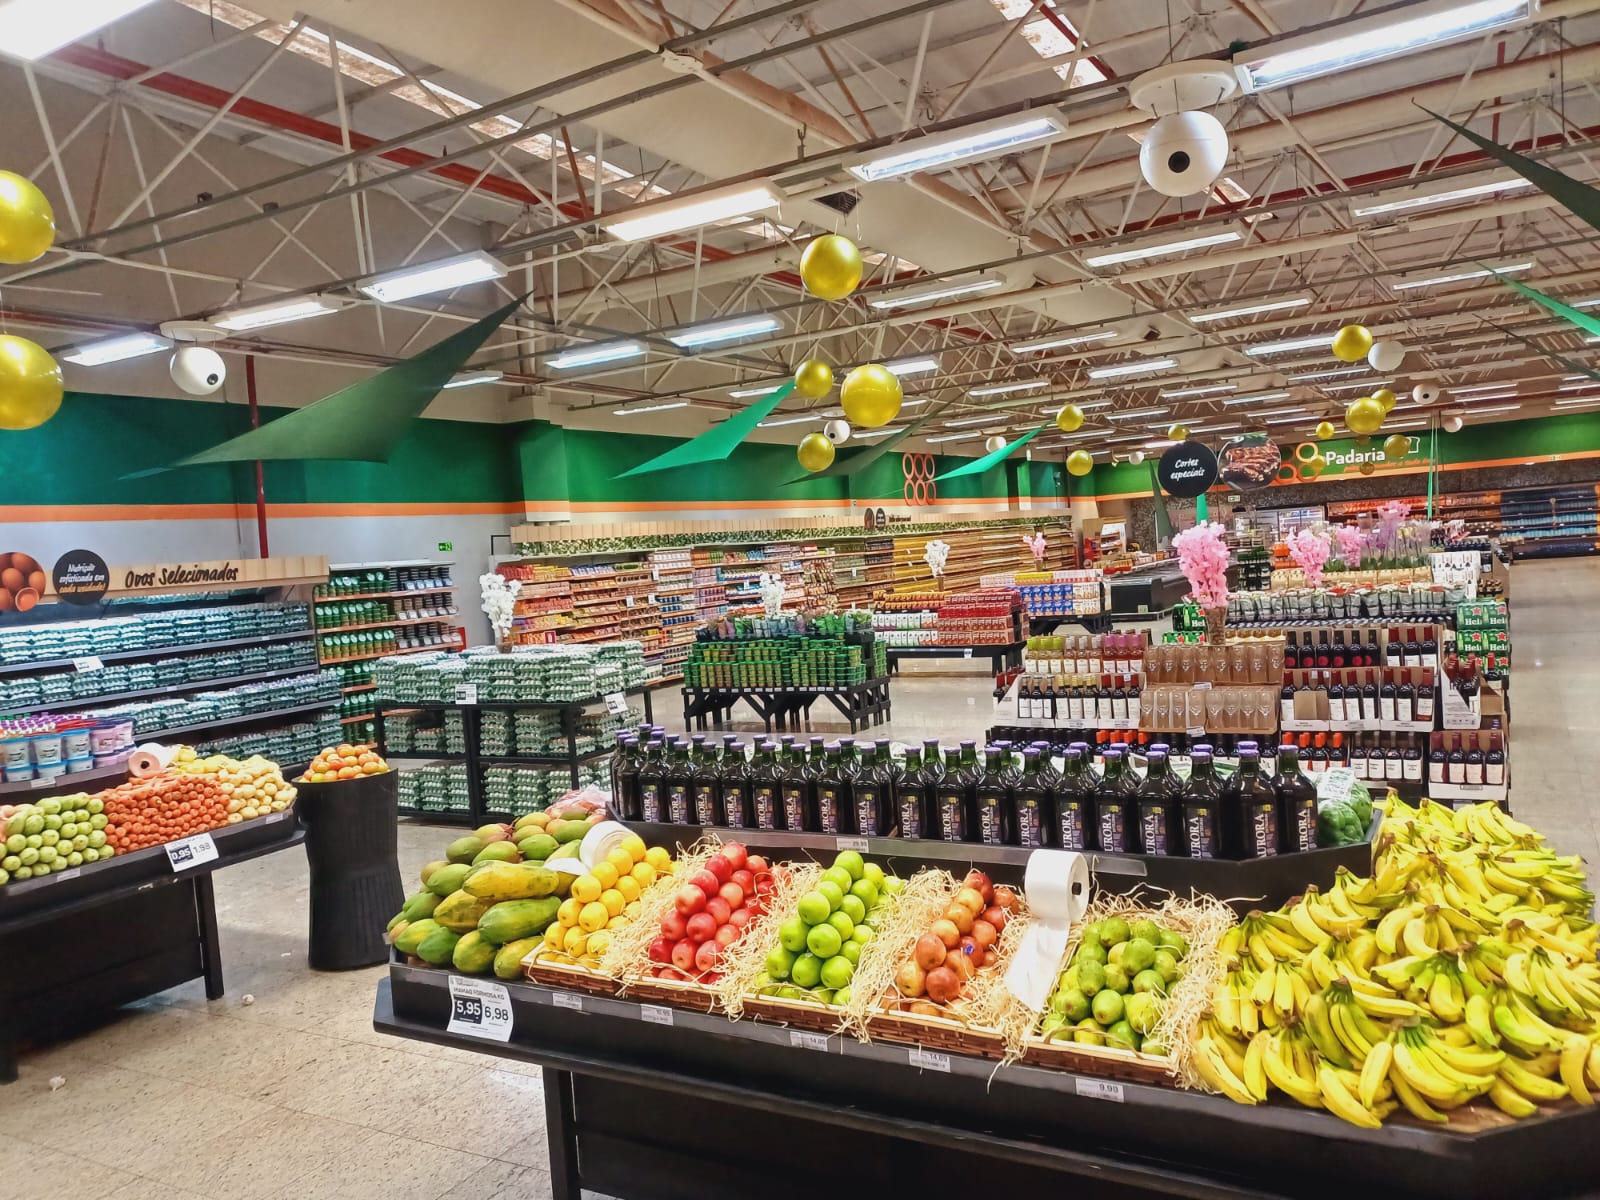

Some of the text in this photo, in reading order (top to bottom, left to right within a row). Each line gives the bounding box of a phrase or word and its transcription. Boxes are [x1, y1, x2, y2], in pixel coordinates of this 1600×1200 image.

[1174, 457, 1200, 469] Cortes
[1325, 447, 1386, 465] Padaria
[1170, 466, 1206, 482] especiais
[124, 561, 239, 588] Ovos Selecionados
[643, 791, 652, 823] URORA
[672, 793, 681, 825] URORA
[696, 794, 706, 826] URORA
[727, 795, 736, 828] URORA
[756, 796, 766, 829] URORA
[786, 797, 795, 830] URORA
[820, 798, 830, 834] URORA
[858, 801, 868, 835] URORA
[901, 803, 911, 838] URORA
[942, 804, 952, 841] URORA
[981, 806, 992, 844] URORA
[1020, 808, 1031, 846] URORA
[1061, 810, 1073, 849] URORA
[1101, 813, 1113, 852] URORA
[1144, 815, 1156, 855] URORA
[1189, 817, 1202, 858] URORA
[1254, 814, 1267, 858] URORA
[1297, 809, 1309, 852] URORA
[456, 1000, 509, 1021] 5,95 6,98
